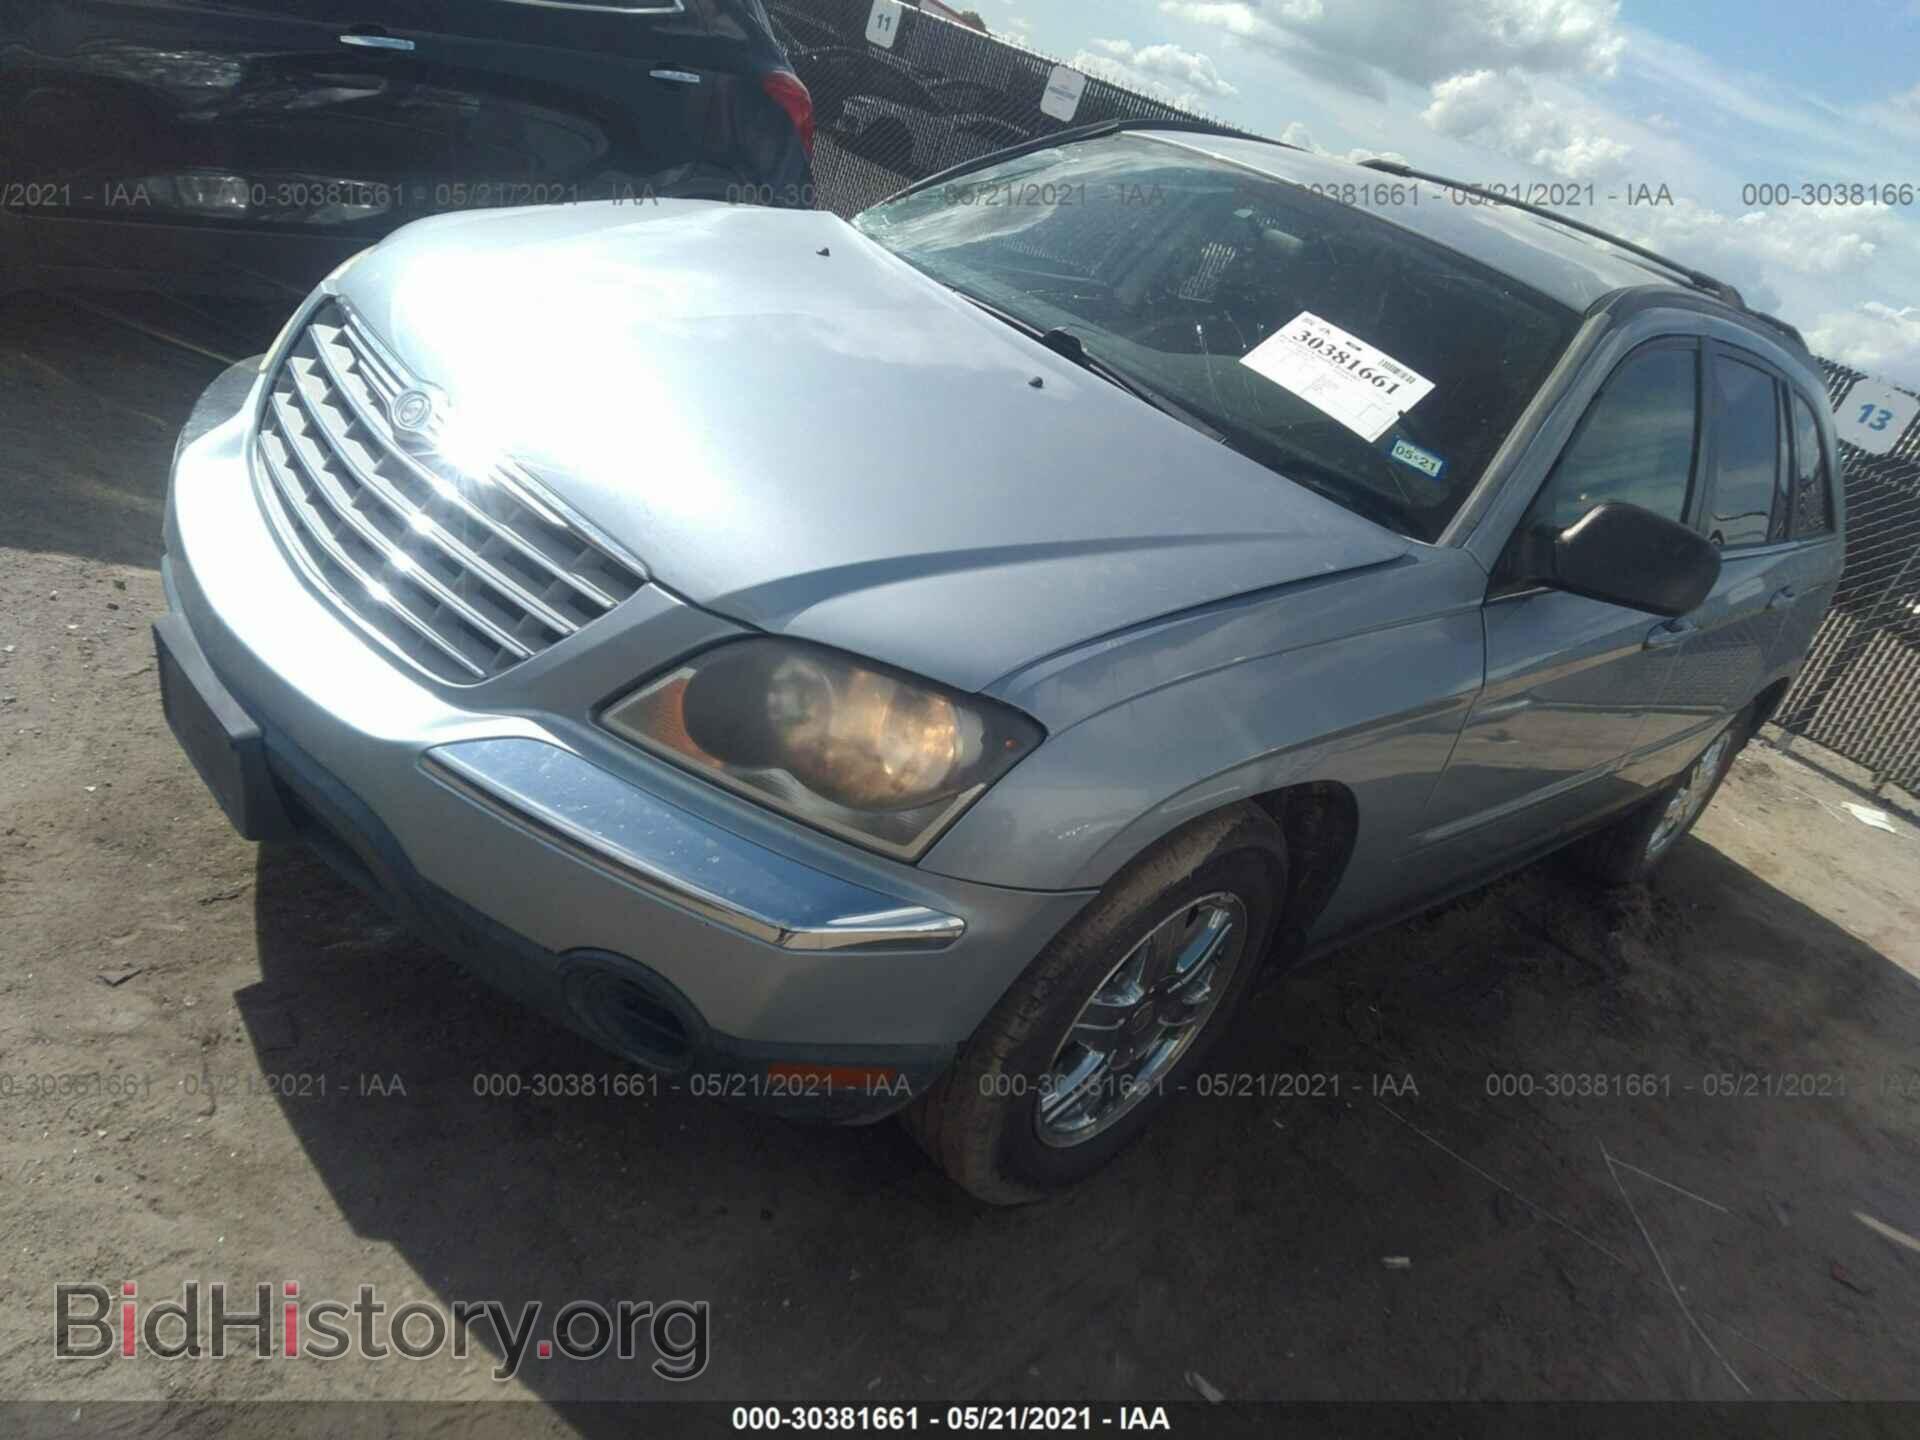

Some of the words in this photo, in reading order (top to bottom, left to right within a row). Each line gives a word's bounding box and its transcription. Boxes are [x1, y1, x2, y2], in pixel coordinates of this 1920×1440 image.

[877, 14, 891, 32] 11
[1293, 330, 1400, 394] 30381661
[1857, 404, 1893, 431] 13
[1395, 446, 1436, 471] 05-21
